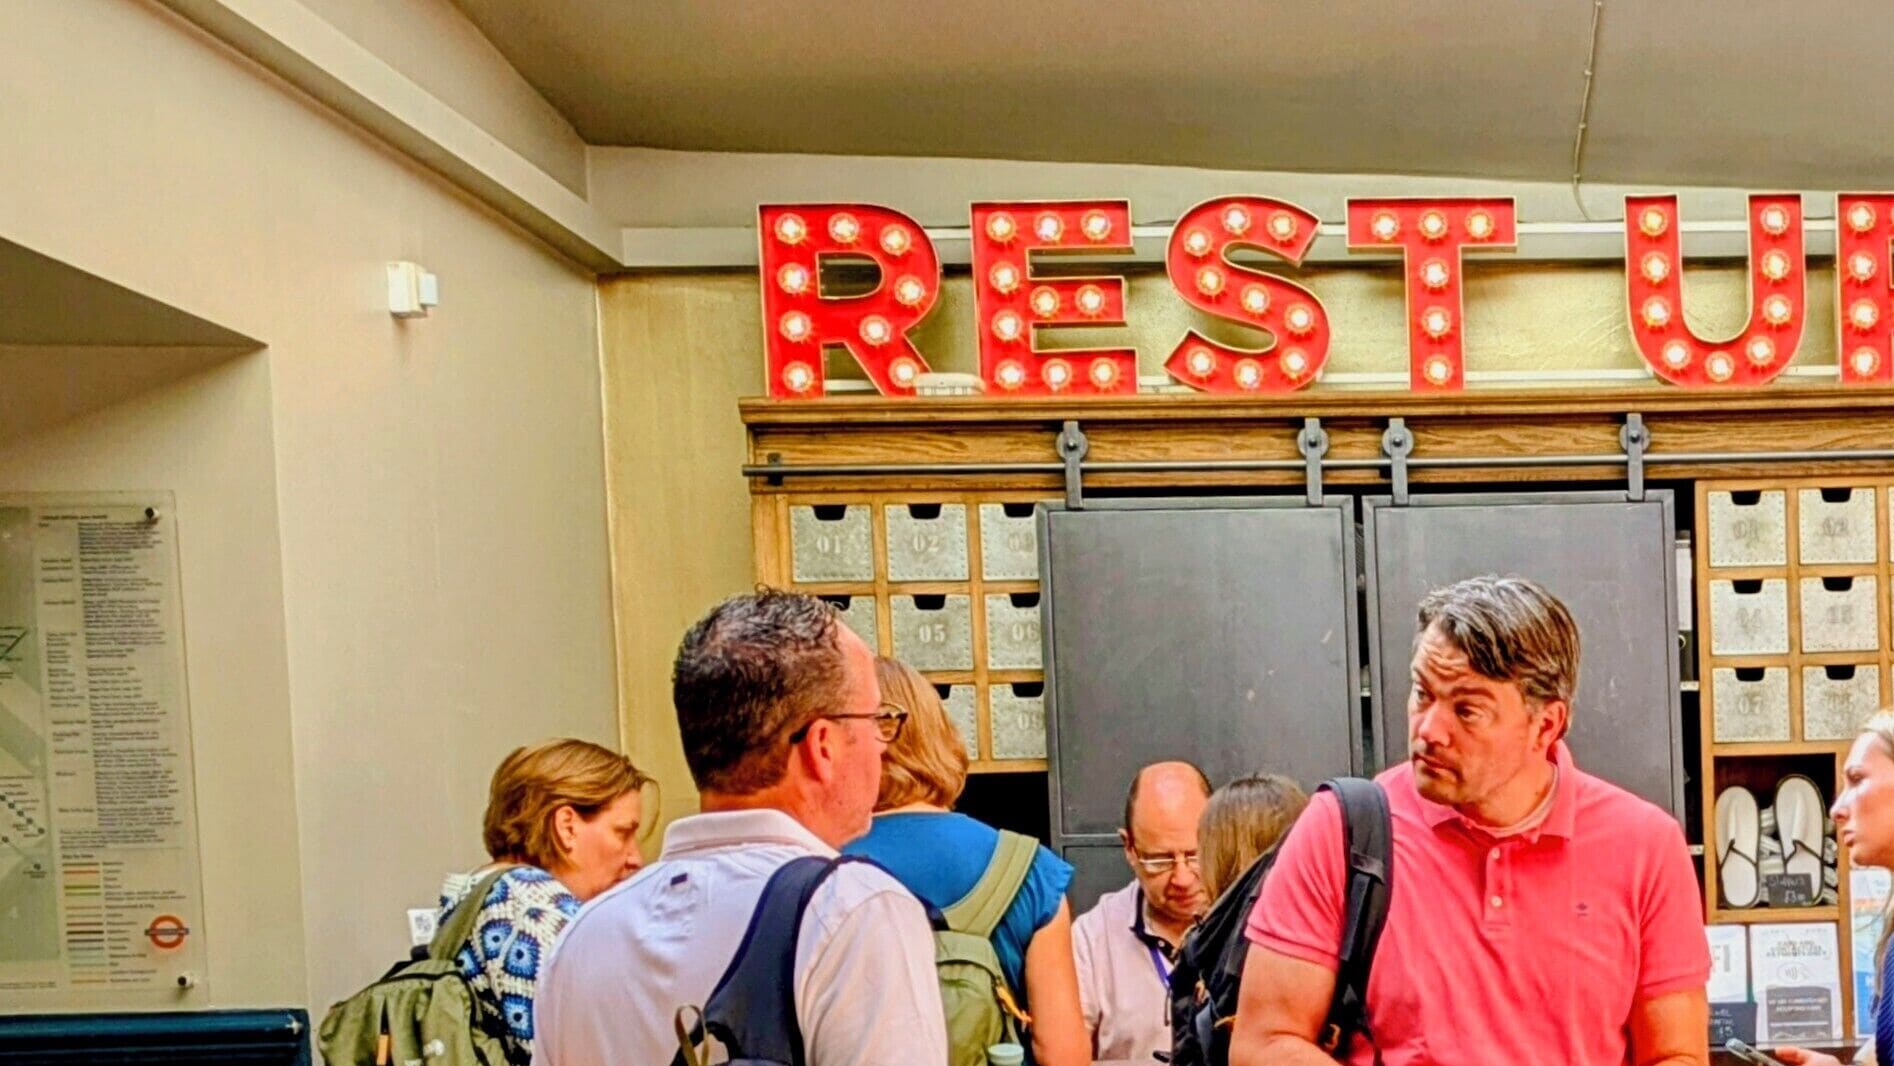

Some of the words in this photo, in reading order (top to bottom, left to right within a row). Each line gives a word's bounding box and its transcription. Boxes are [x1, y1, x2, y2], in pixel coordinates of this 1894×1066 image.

[757, 193, 1518, 399] REST
[816, 535, 842, 554] 01
[912, 534, 940, 553] 02
[918, 624, 946, 643] 05
